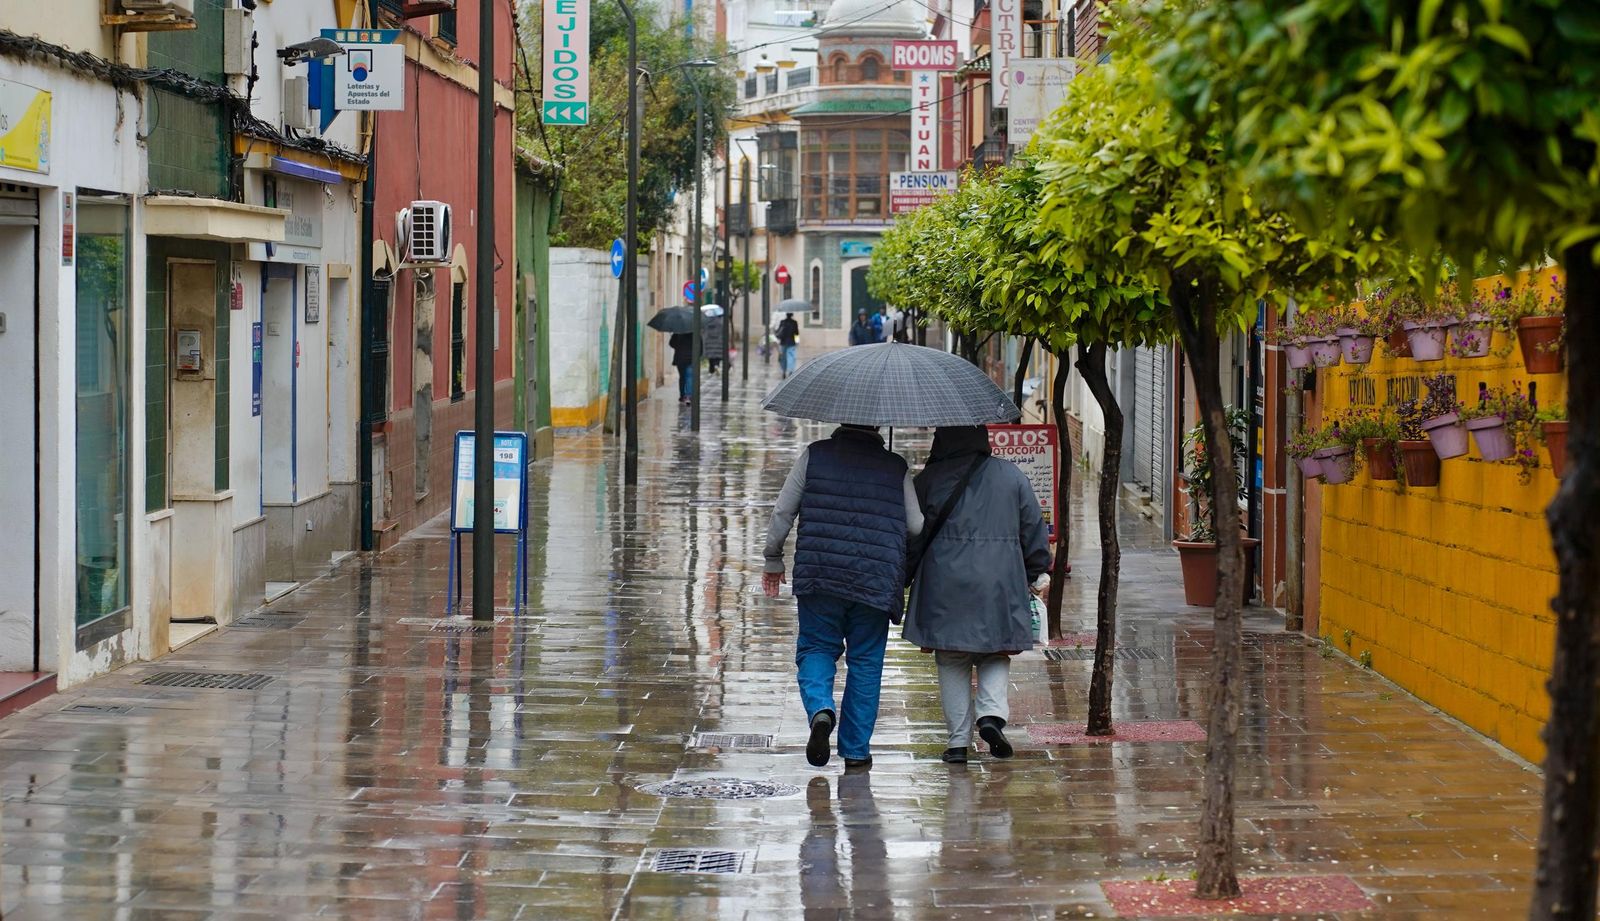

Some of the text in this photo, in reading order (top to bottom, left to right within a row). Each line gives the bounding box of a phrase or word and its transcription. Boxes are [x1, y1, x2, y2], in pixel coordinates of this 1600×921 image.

[894, 45, 955, 66] ROOMS
[918, 86, 930, 170] TETUAN
[900, 175, 947, 188] PENSION
[992, 447, 1046, 455] OTOCOPIA
